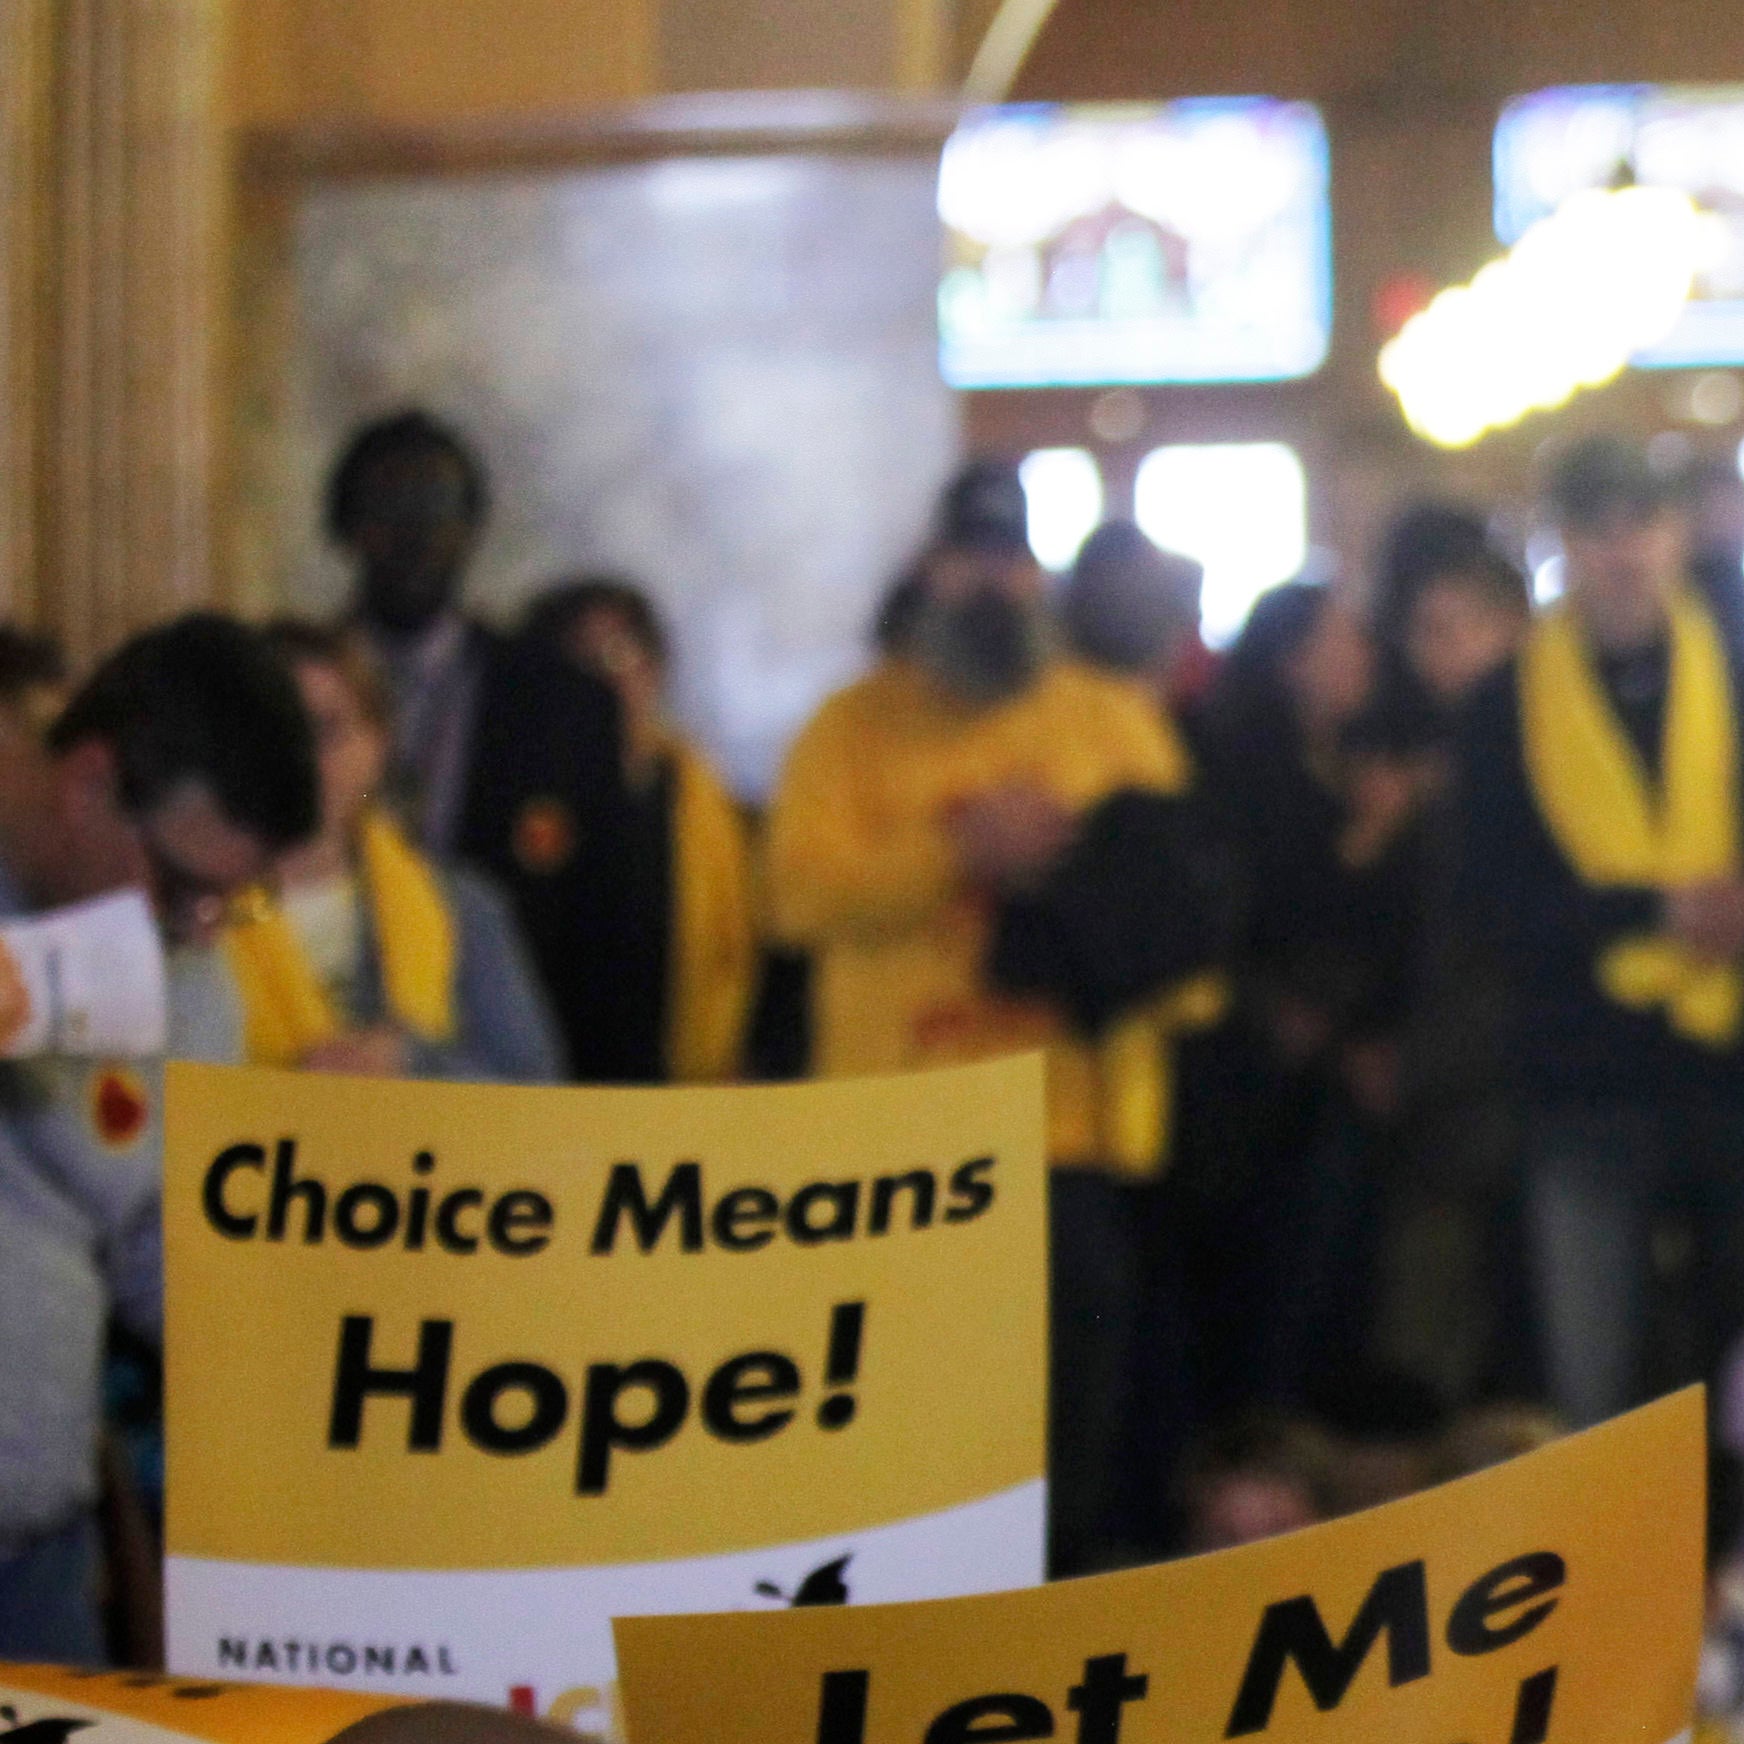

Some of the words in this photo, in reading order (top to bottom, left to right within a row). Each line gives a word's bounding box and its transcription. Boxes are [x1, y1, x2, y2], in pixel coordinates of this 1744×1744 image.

[203, 1139, 554, 1257] Choice
[590, 1156, 997, 1256] Means
[326, 1301, 866, 1496] Hope!
[218, 1637, 458, 1675] NATIONAL
[1223, 1549, 1566, 1739] Me
